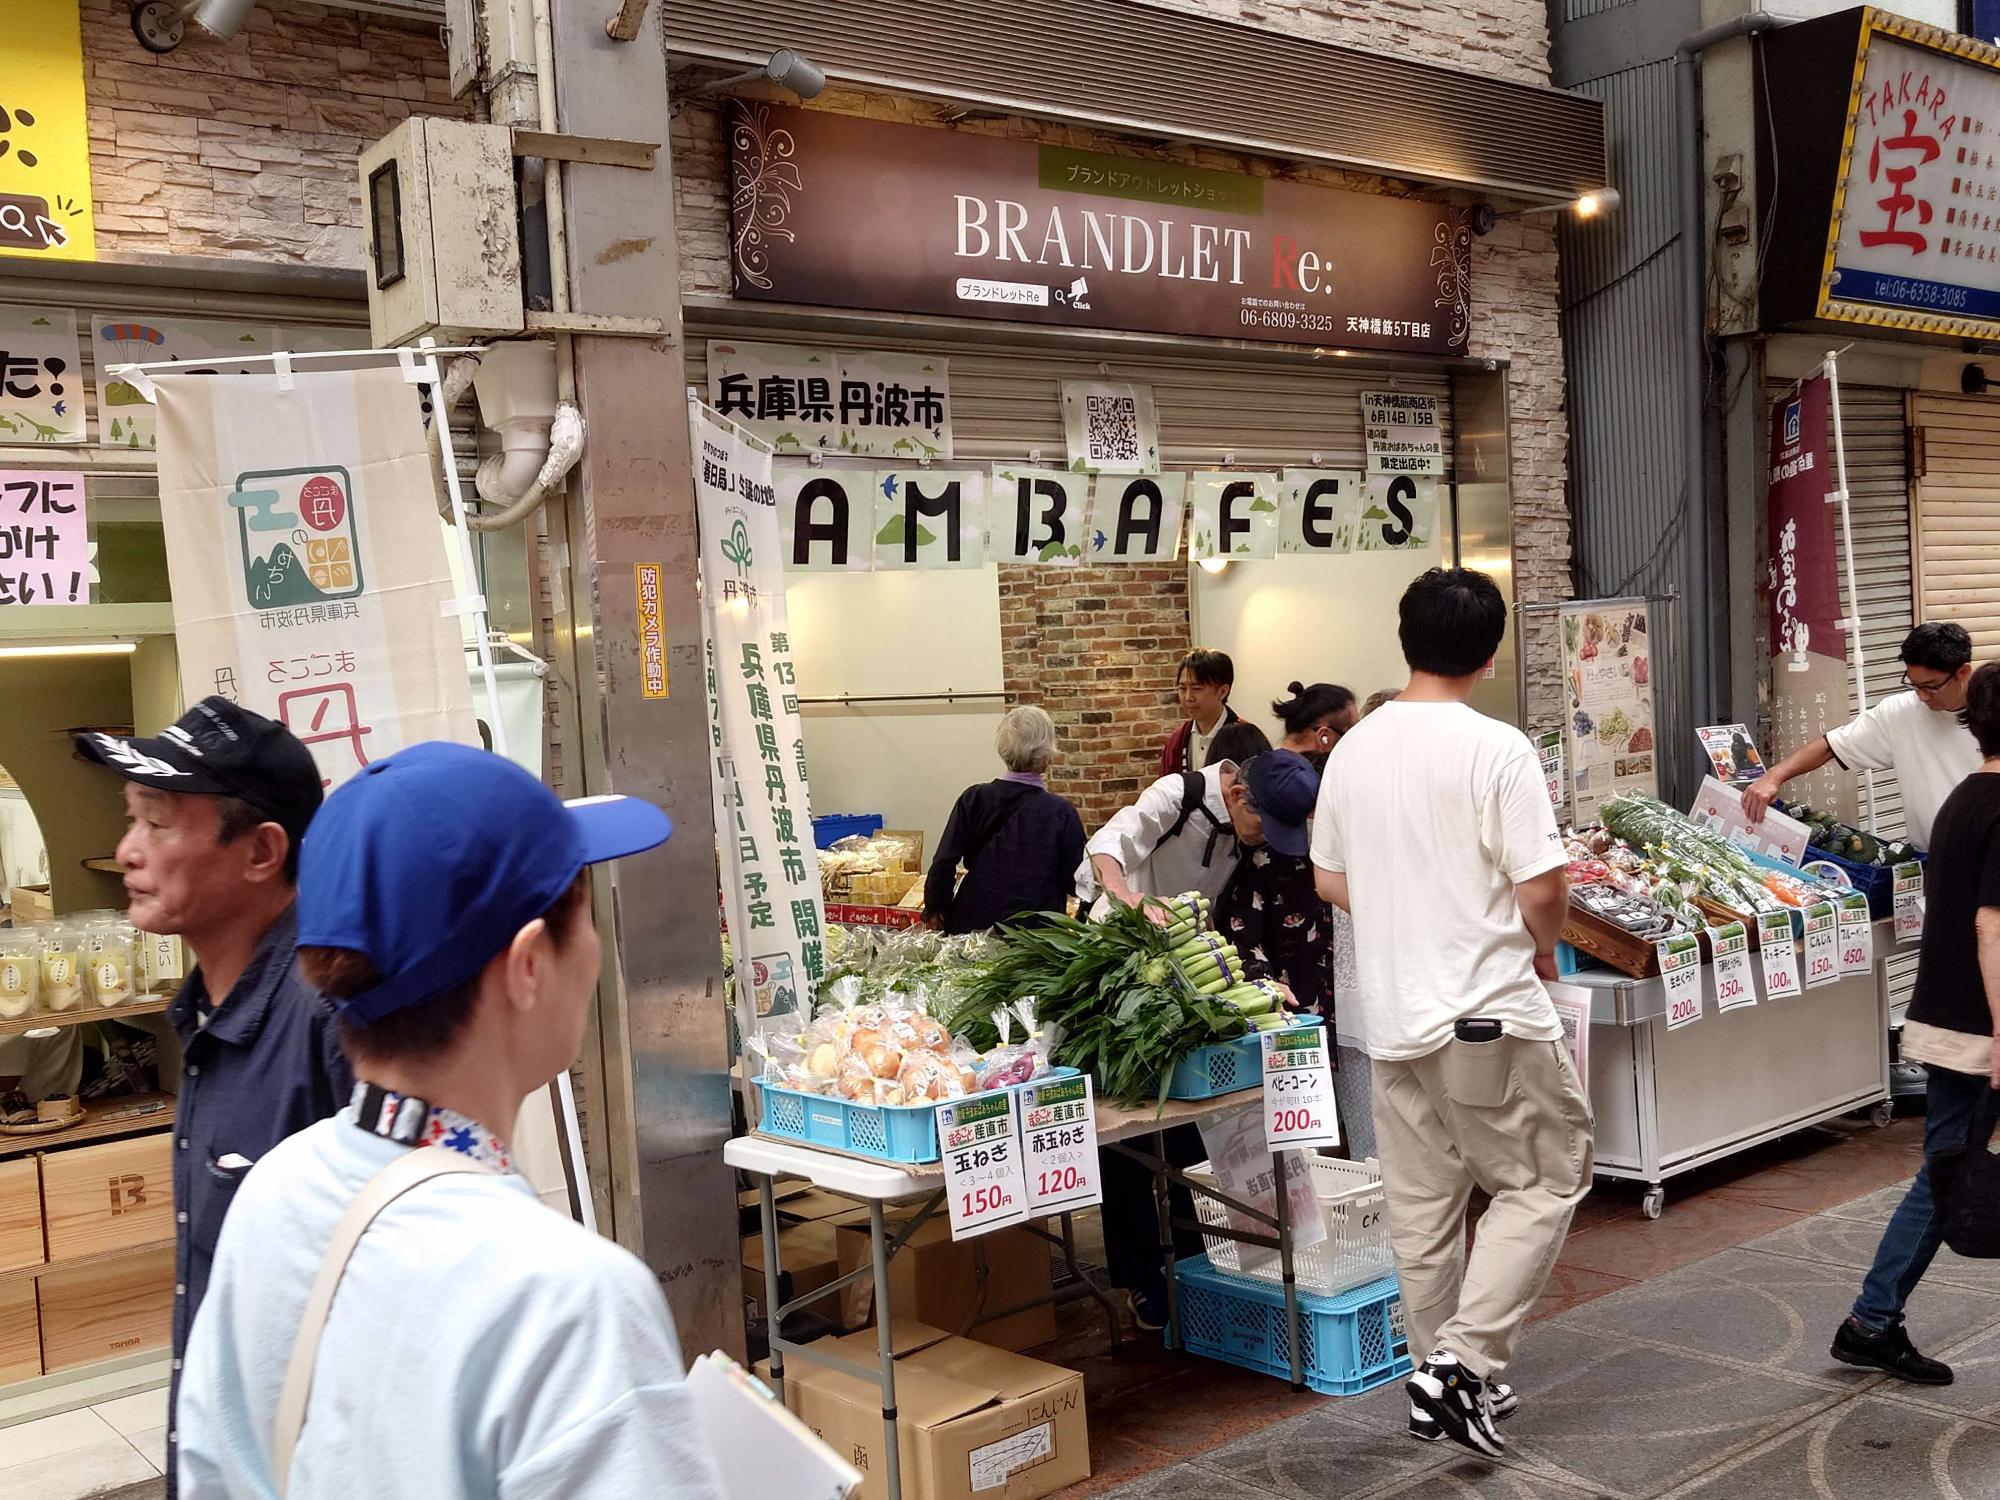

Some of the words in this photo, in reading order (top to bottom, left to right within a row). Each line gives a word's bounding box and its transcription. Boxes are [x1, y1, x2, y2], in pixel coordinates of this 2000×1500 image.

[1865, 71, 1956, 141] TAKARA
[1859, 109, 1941, 256] 宝
[953, 194, 1251, 285] BRANDLET
[1272, 233, 1334, 296] Re:
[961, 283, 1040, 304] ブランドレットRe
[1072, 300, 1091, 311] Click
[1875, 278, 1967, 308] tel:06-6358-3085
[1240, 308, 1333, 331] 06-6809-3325
[1346, 316, 1431, 339] 天神橋筋5丁目店
[714, 372, 945, 430] 兵庫県丹波市
[1365, 394, 1436, 410] in天神橋筋商店街
[1371, 410, 1433, 425] 6月14日/15日
[1373, 441, 1440, 453] 丹波おばあちゃんの里
[0, 481, 77, 513] フに
[640, 568, 663, 695] 防犯カメラ作動中
[769, 632, 800, 716] 第13回
[740, 643, 807, 885] 兵庫県丹波市
[1809, 933, 1832, 948] にんじん
[1810, 957, 1833, 975] 150円
[1843, 948, 1866, 964] 450円
[1720, 979, 1744, 999] 250円
[1768, 971, 1792, 989] 100円
[1671, 999, 1696, 1020] 200円
[1271, 1073, 1317, 1091] ベビーコーン
[1273, 1108, 1322, 1133] 200円
[1032, 1126, 1085, 1154] 赤玉ねぎ
[954, 1142, 1008, 1175] 玉ねぎ
[1038, 1166, 1086, 1197] 120円
[962, 1184, 1012, 1218] 150円
[1026, 1389, 1079, 1427] にんじん
